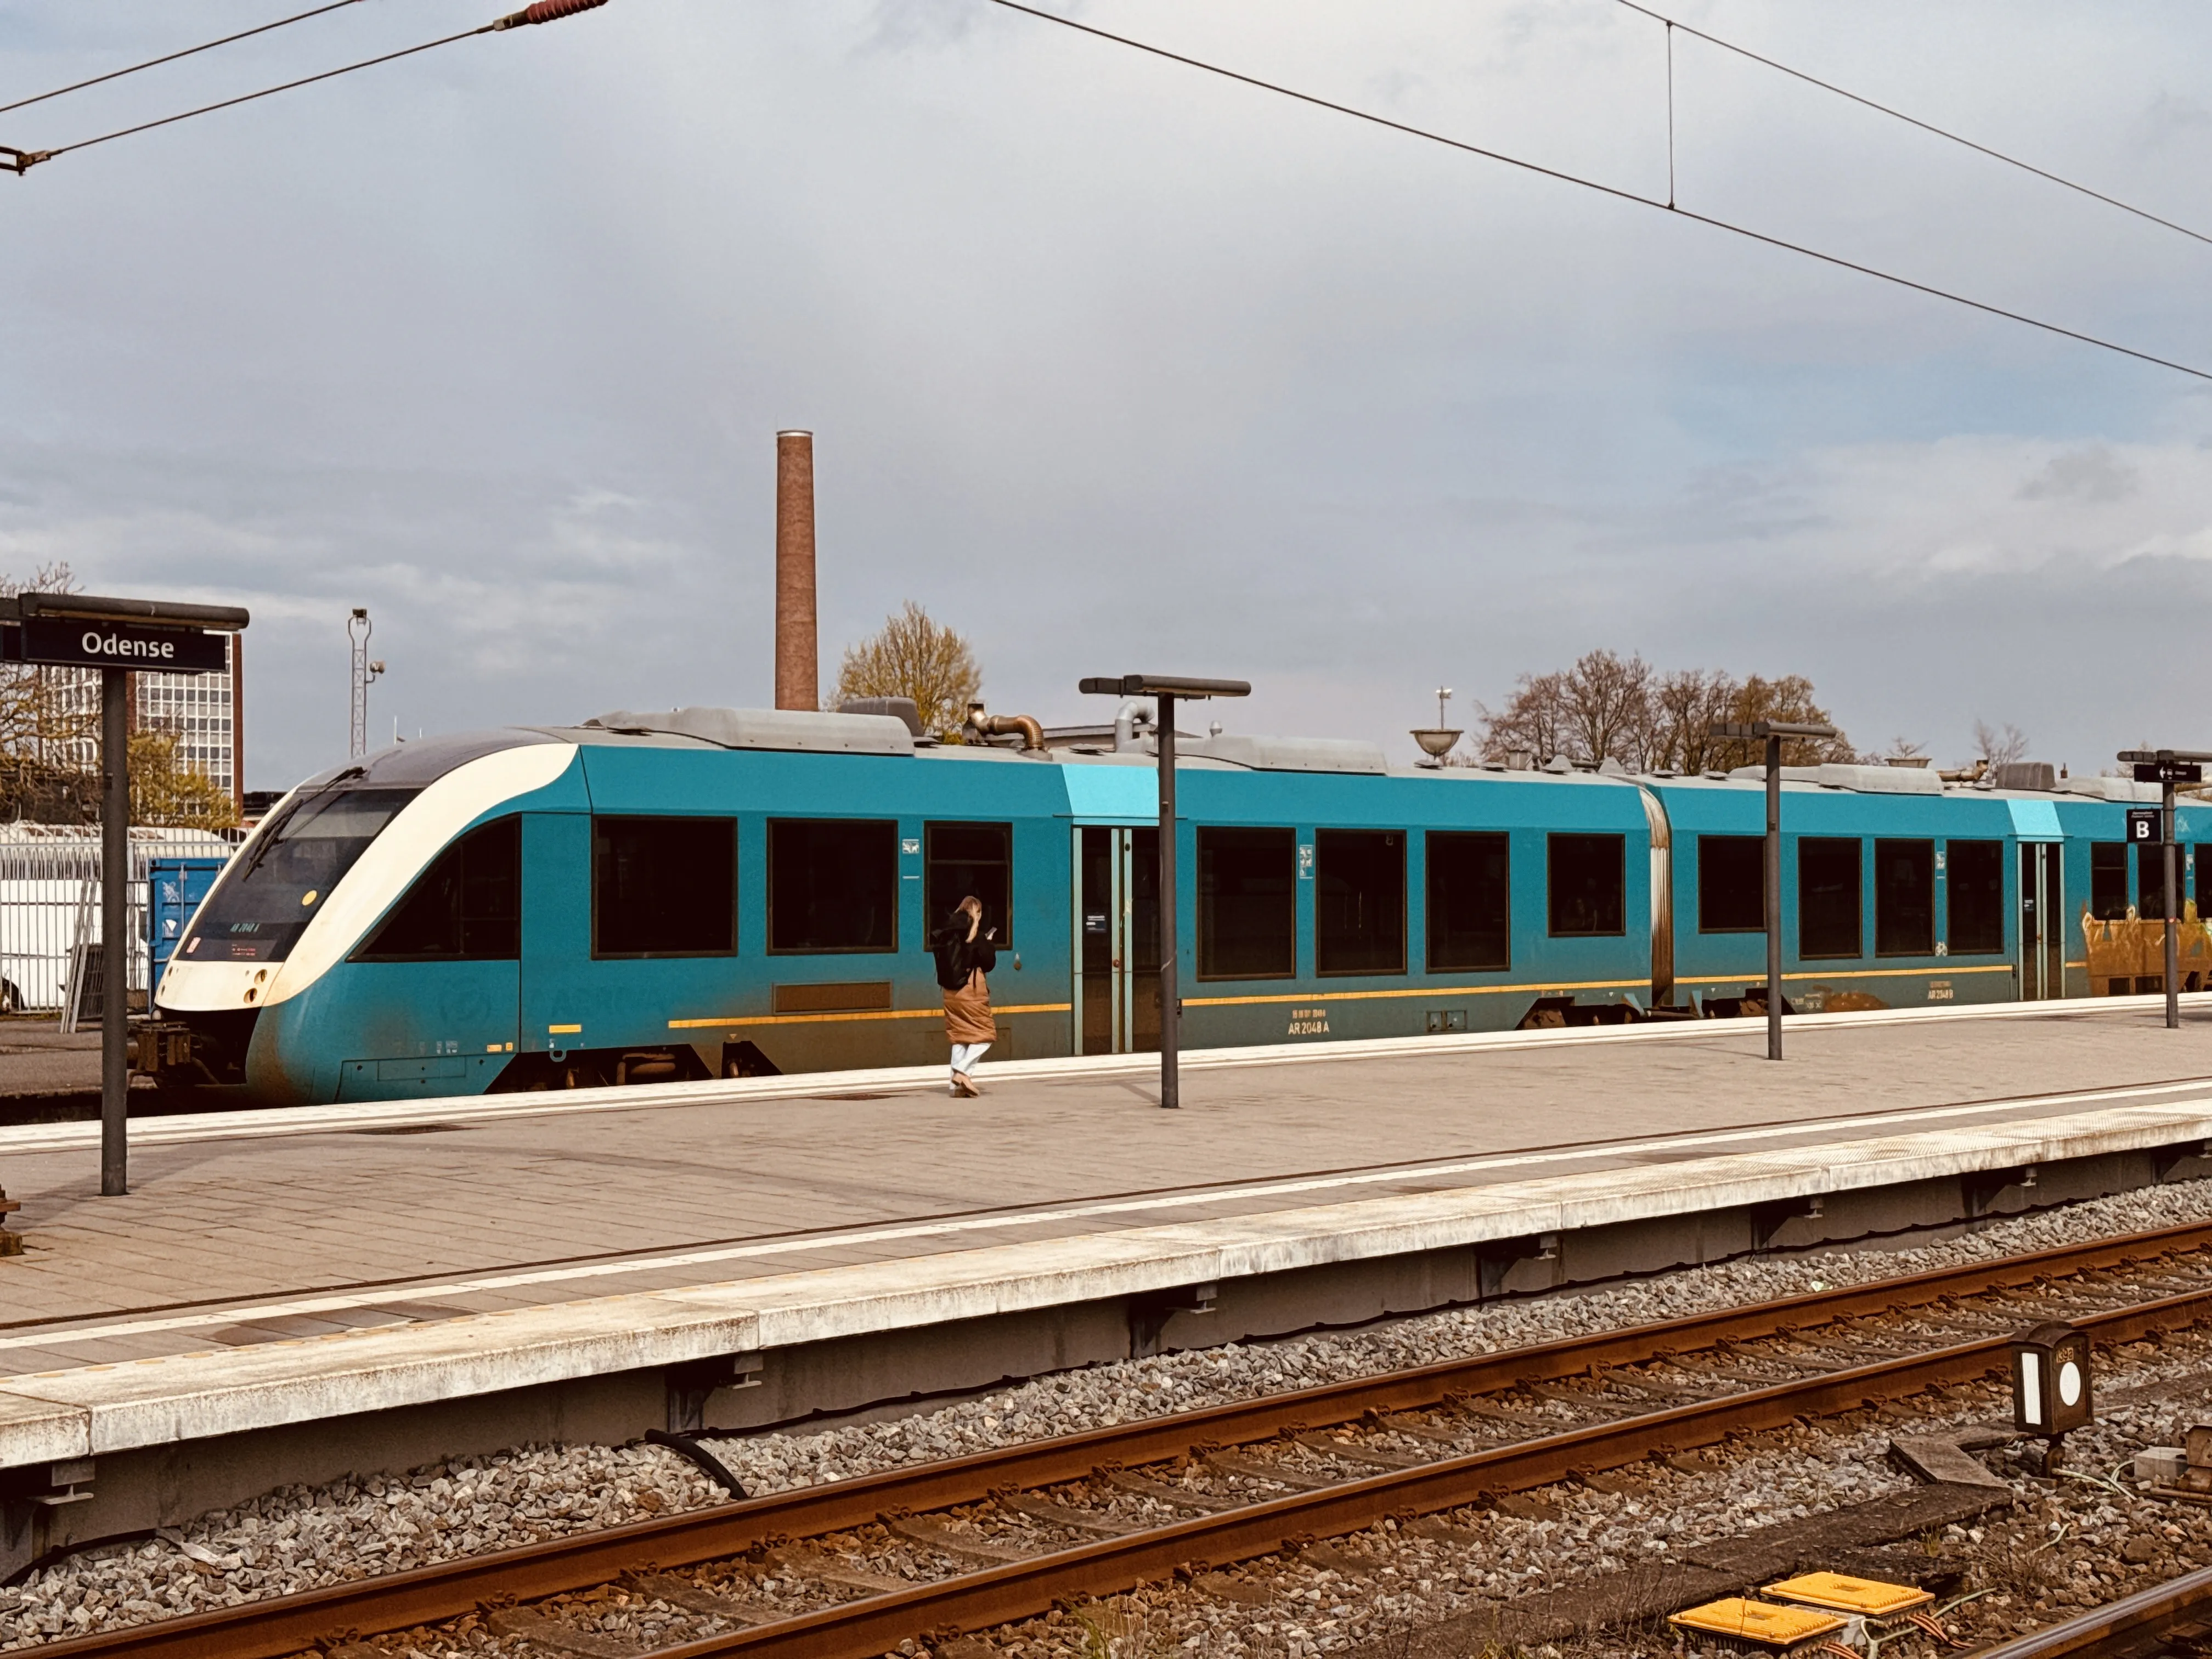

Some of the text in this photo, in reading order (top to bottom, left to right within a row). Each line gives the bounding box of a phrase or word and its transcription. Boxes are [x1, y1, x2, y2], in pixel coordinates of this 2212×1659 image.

[82, 631, 174, 658] Odense
[2136, 821, 2149, 839] B
[1288, 1020, 1330, 1035] AR 2048 A
